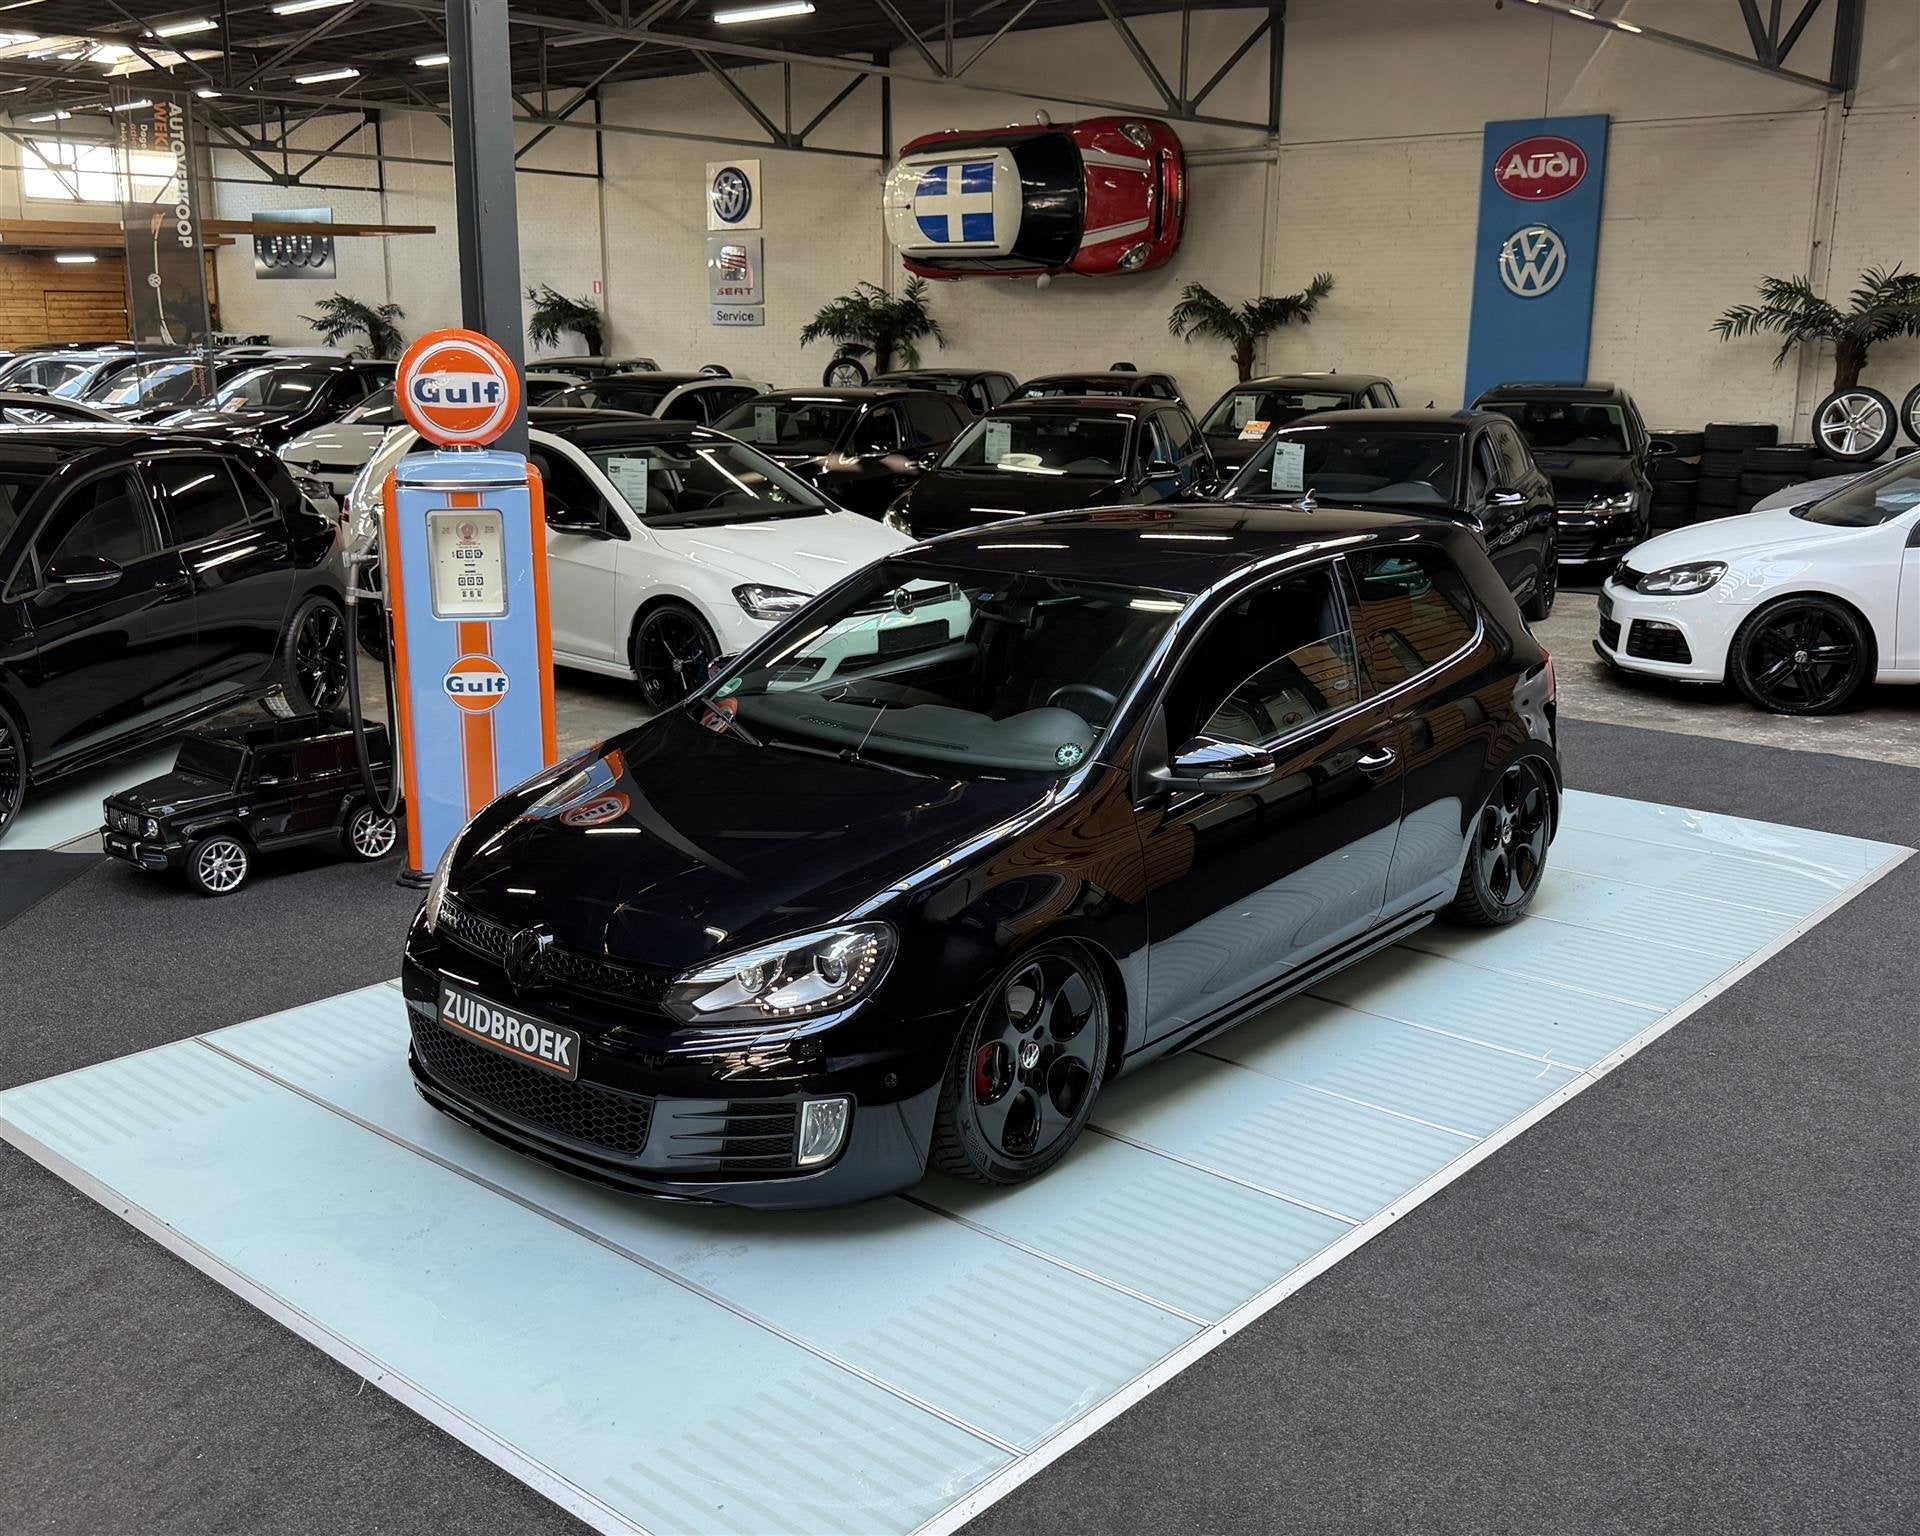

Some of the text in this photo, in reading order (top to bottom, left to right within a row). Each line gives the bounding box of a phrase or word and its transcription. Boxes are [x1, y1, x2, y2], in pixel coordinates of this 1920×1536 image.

[168, 102, 193, 248] AUTOVERKOOP
[716, 287, 753, 296] SEAT
[717, 310, 754, 322] Service
[414, 377, 500, 403] Gulf
[446, 676, 506, 692] Gulf
[443, 988, 572, 1066] ZUIDBROEK
